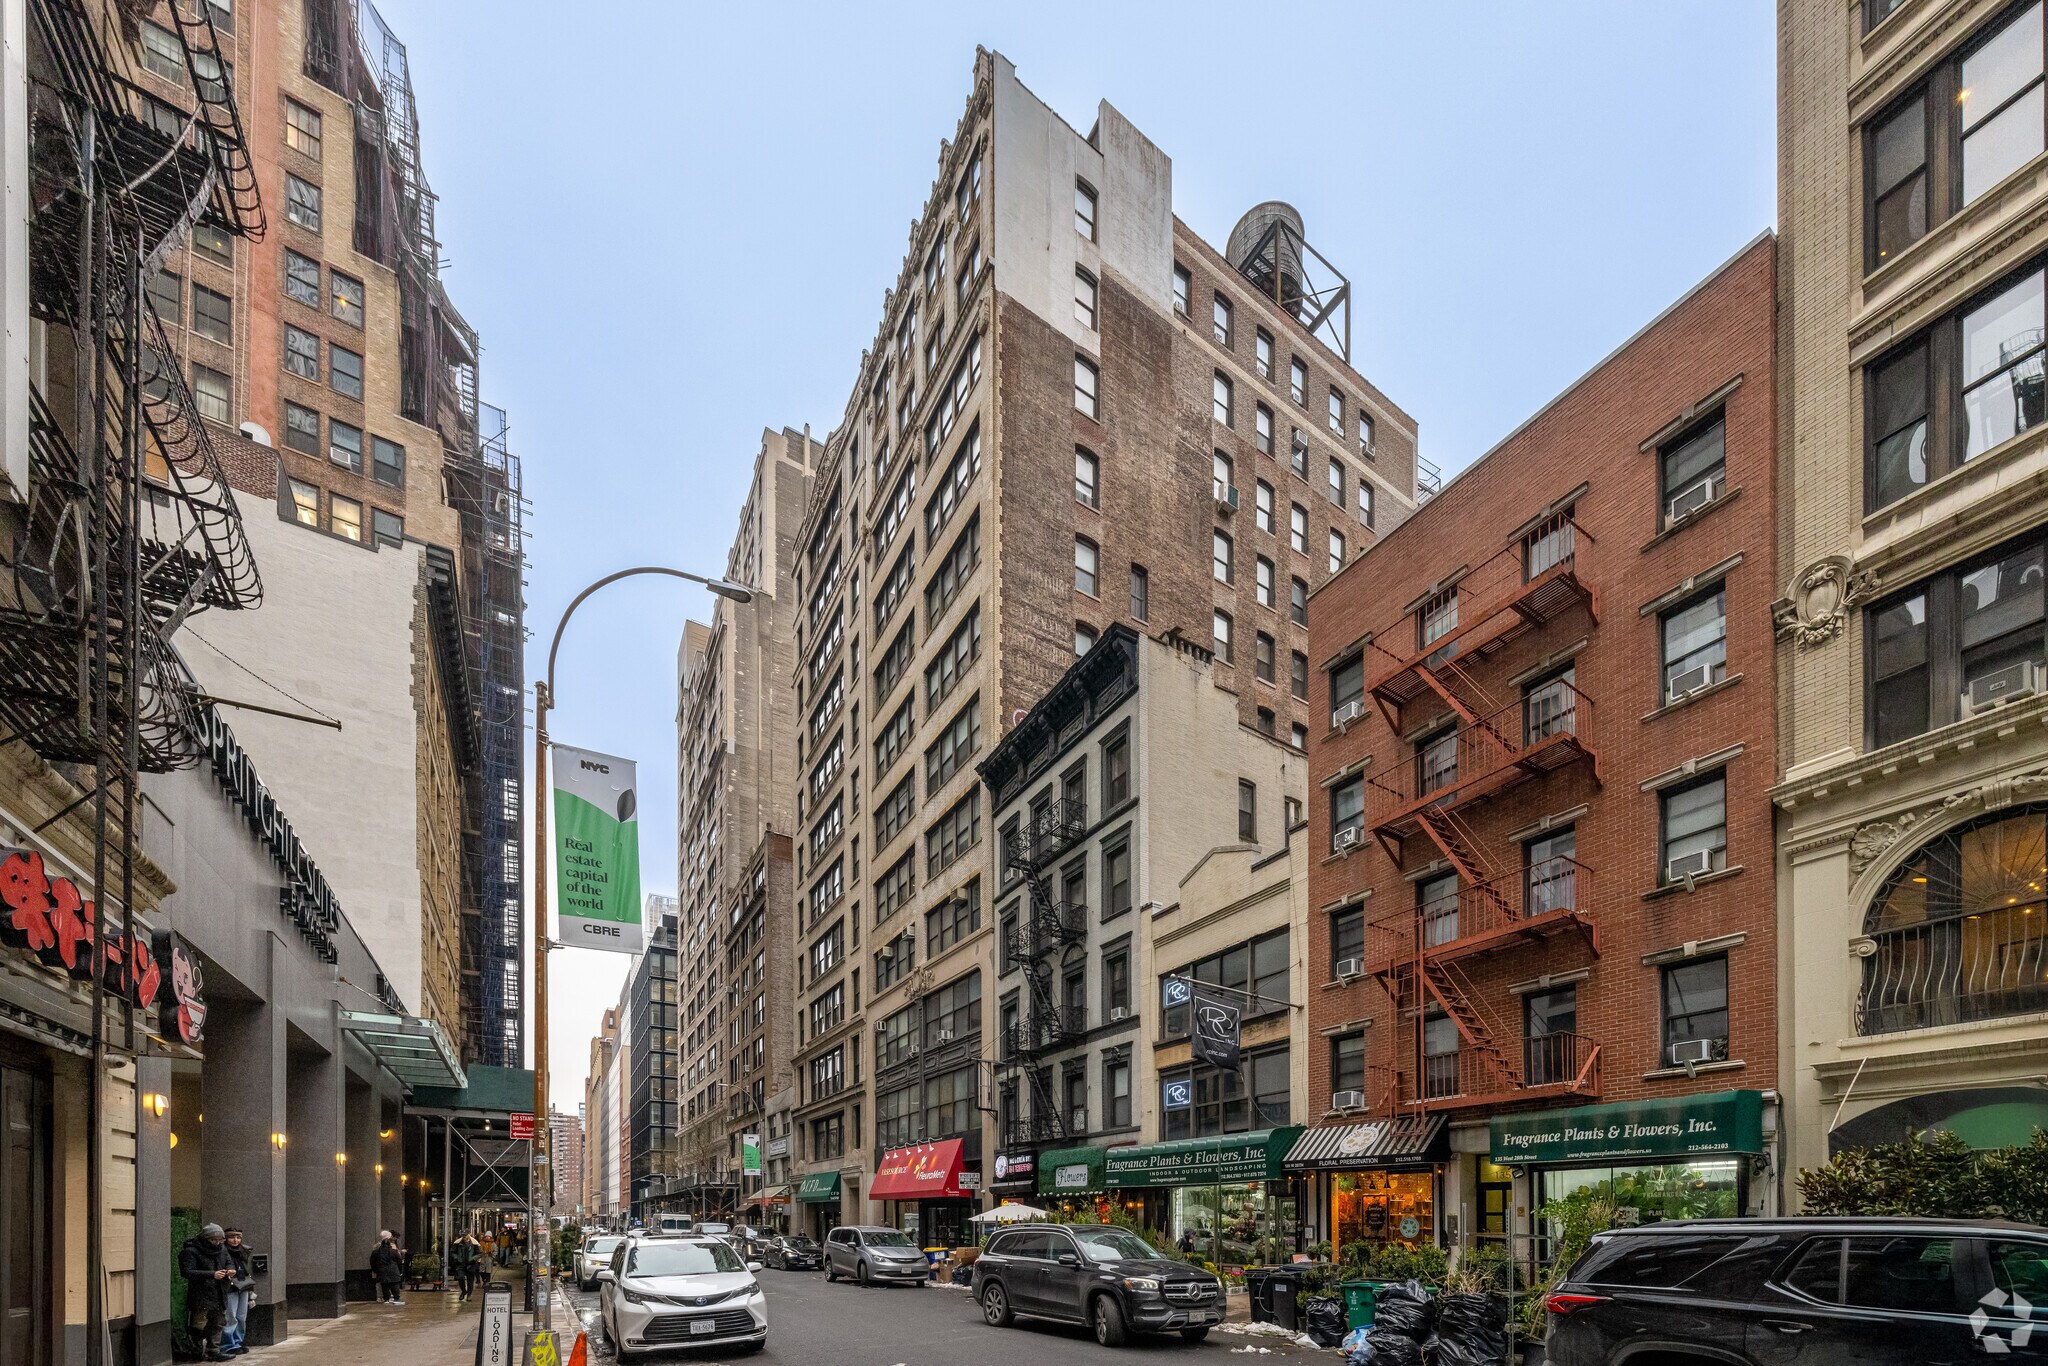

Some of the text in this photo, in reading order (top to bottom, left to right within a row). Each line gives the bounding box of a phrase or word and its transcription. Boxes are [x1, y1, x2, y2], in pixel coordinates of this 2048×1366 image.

[580, 759, 610, 775] NYC
[564, 837, 593, 853] Real
[565, 853, 603, 869] estate
[565, 867, 608, 884] capital
[566, 881, 602, 896] of the
[567, 896, 604, 911] world
[582, 924, 621, 937] CBRE
[1503, 1118, 1717, 1148] Fragrance Plants & Flowers, Inc.
[1687, 1142, 1729, 1151] 212-564-2103
[1106, 1146, 1267, 1172] Fragrance Plants & Flowers, Inc.
[1318, 1157, 1379, 1167] FLORAL PRESERVATION
[1057, 1166, 1088, 1186] Flowers
[1181, 1167, 1212, 1175] OUTDOOR
[1496, 1171, 1512, 1180] 135
[487, 1306, 508, 1314] HOTEL
[490, 1315, 501, 1363] LOADING
